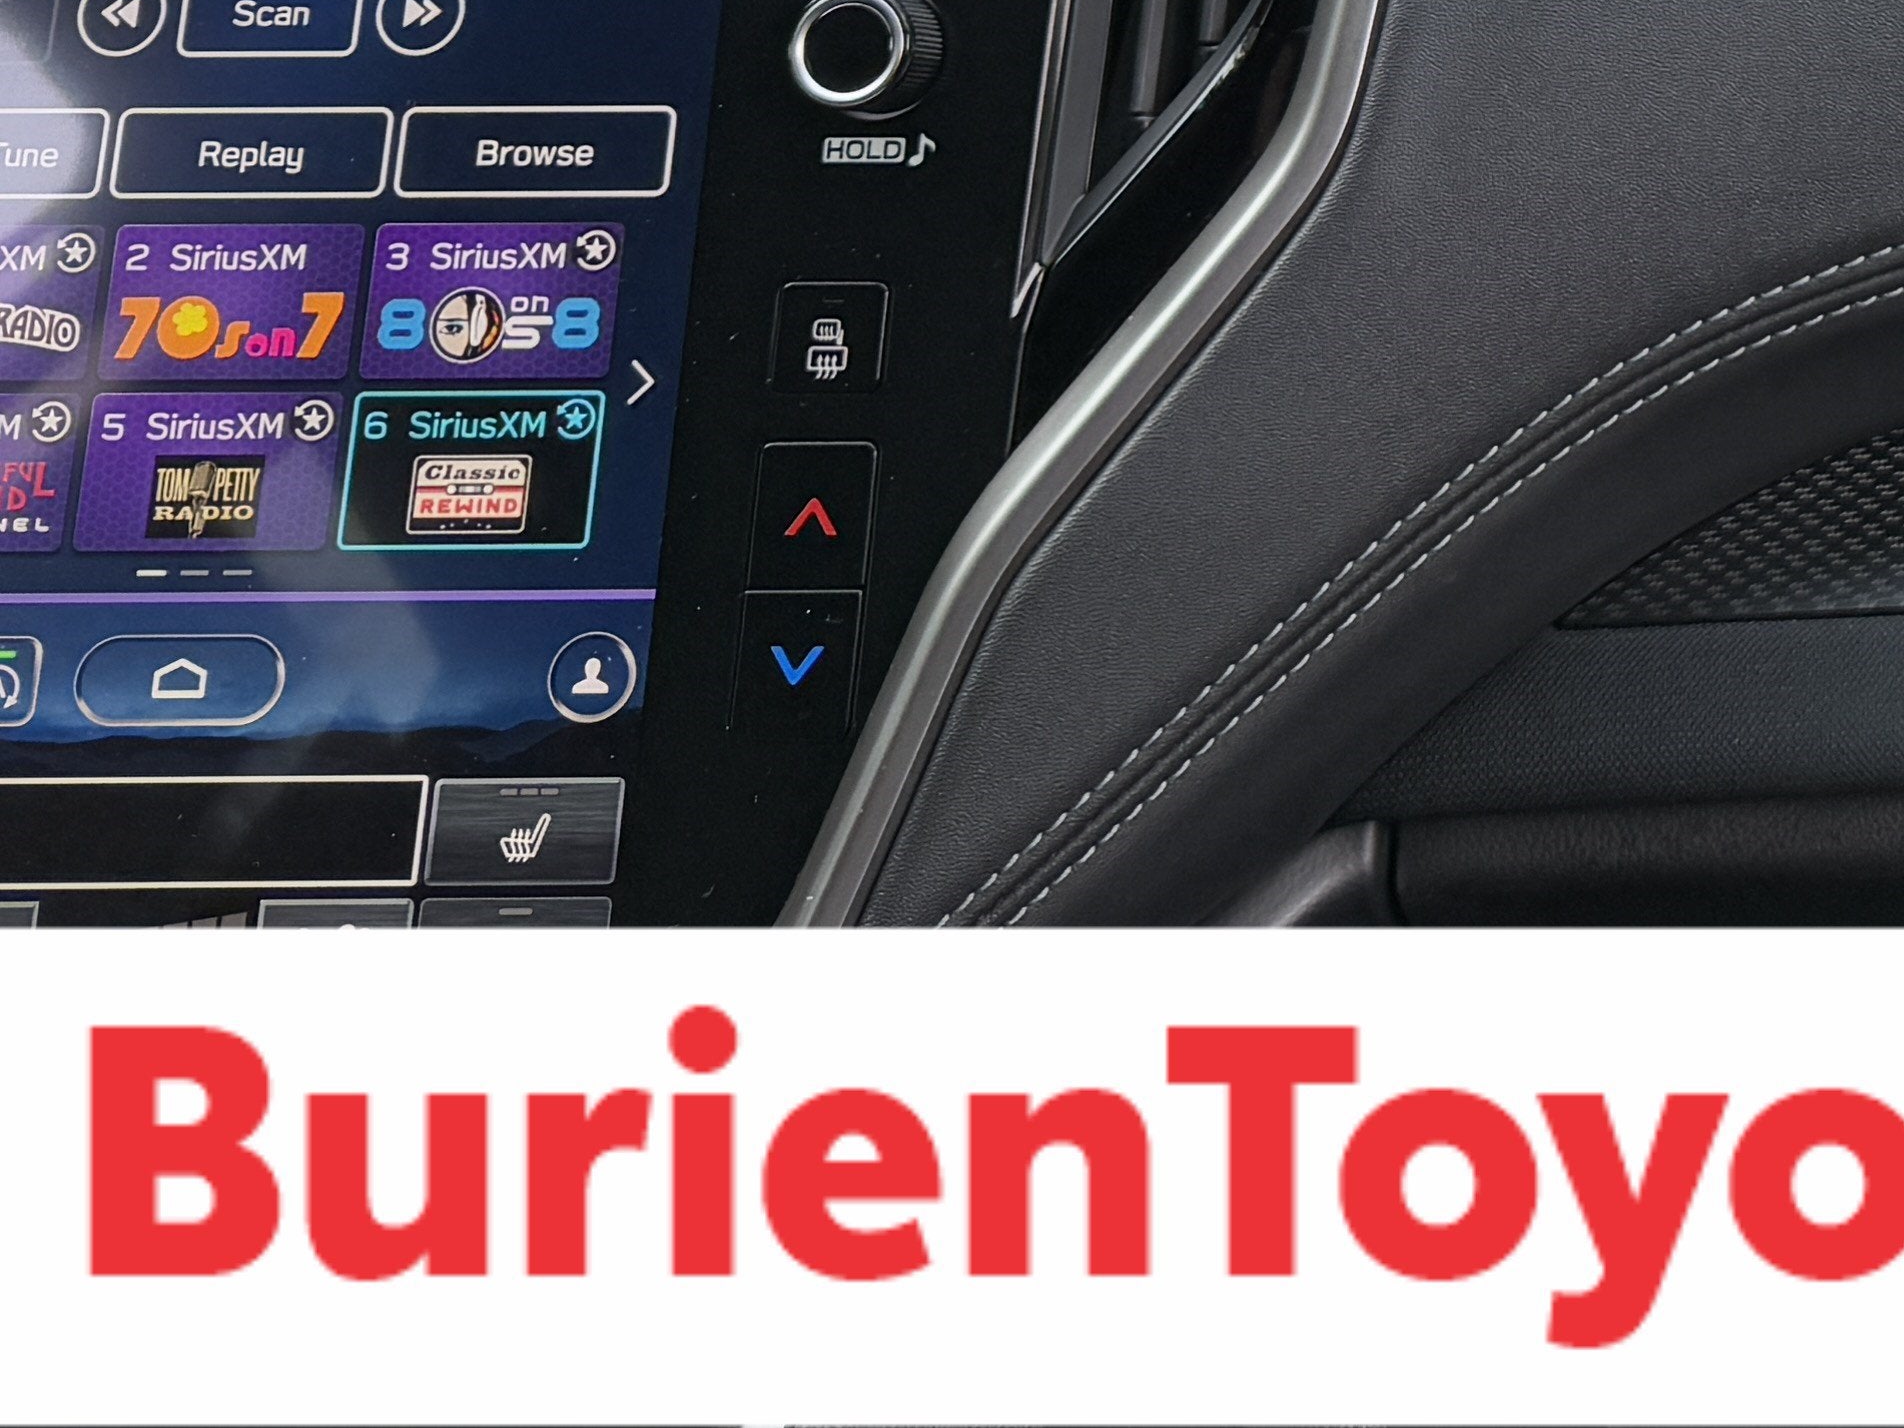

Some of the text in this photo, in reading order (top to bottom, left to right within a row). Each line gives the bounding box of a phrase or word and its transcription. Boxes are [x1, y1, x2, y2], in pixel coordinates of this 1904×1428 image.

[232, 0, 310, 27] Scan
[198, 140, 304, 174] Replay
[475, 139, 595, 167] Browse
[826, 140, 902, 159] HOLD
[125, 243, 307, 271] 2 SiriusXM
[385, 242, 567, 271] 3 SiriusXM
[101, 412, 285, 441] 5 SiriusXM
[364, 410, 547, 440] 6 SiriusXM
[155, 467, 261, 502] TOM PETTY
[424, 463, 520, 481] Classic
[153, 505, 254, 521] RADIO
[419, 498, 518, 514] REWIND
